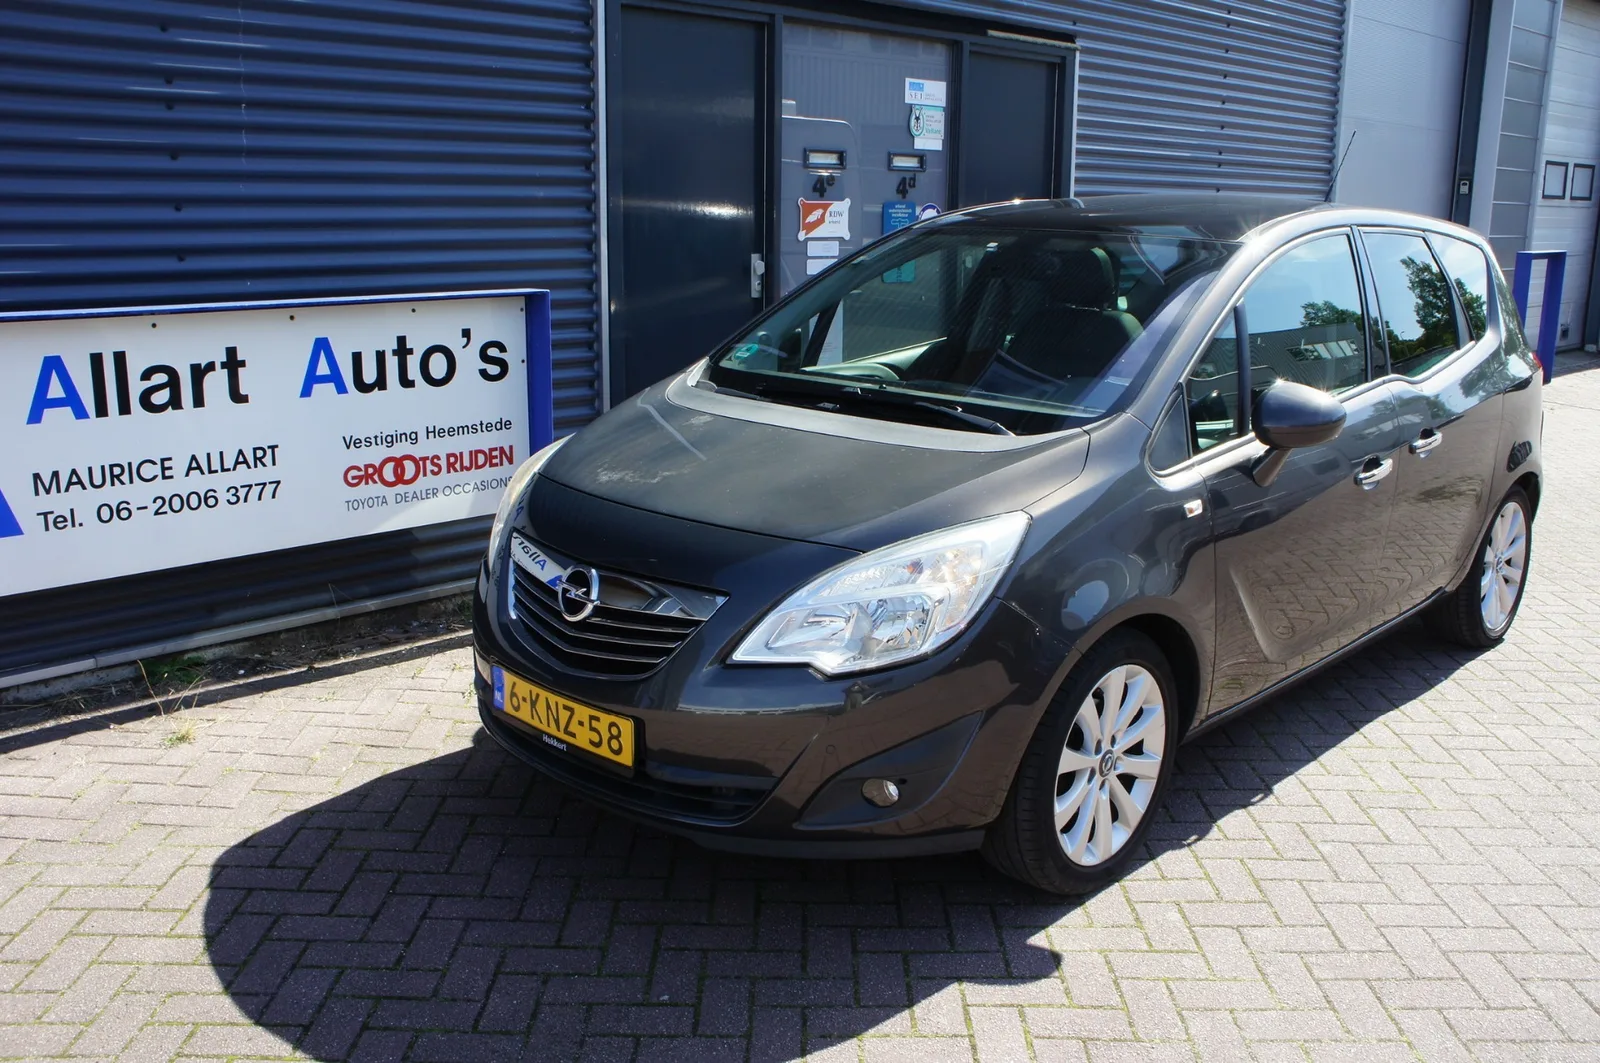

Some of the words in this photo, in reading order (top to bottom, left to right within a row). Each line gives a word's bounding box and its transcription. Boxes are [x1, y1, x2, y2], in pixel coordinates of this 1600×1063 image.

[828, 210, 844, 218] RDW
[26, 346, 249, 425] Allart
[299, 328, 510, 398] Auto's
[342, 431, 419, 450] Vestiging
[426, 417, 513, 440] Heemstede
[32, 457, 174, 496] MAURICE
[184, 444, 279, 477] ALLART
[343, 453, 443, 488] GROOTS
[446, 444, 514, 475] RIJDEN
[36, 508, 84, 532] Tel.
[96, 488, 219, 524] 06-2006
[225, 480, 282, 505] 3777
[345, 496, 388, 511] TOYOTA
[395, 488, 439, 504] DEALER
[509, 681, 623, 756] 6-KNZ-58
